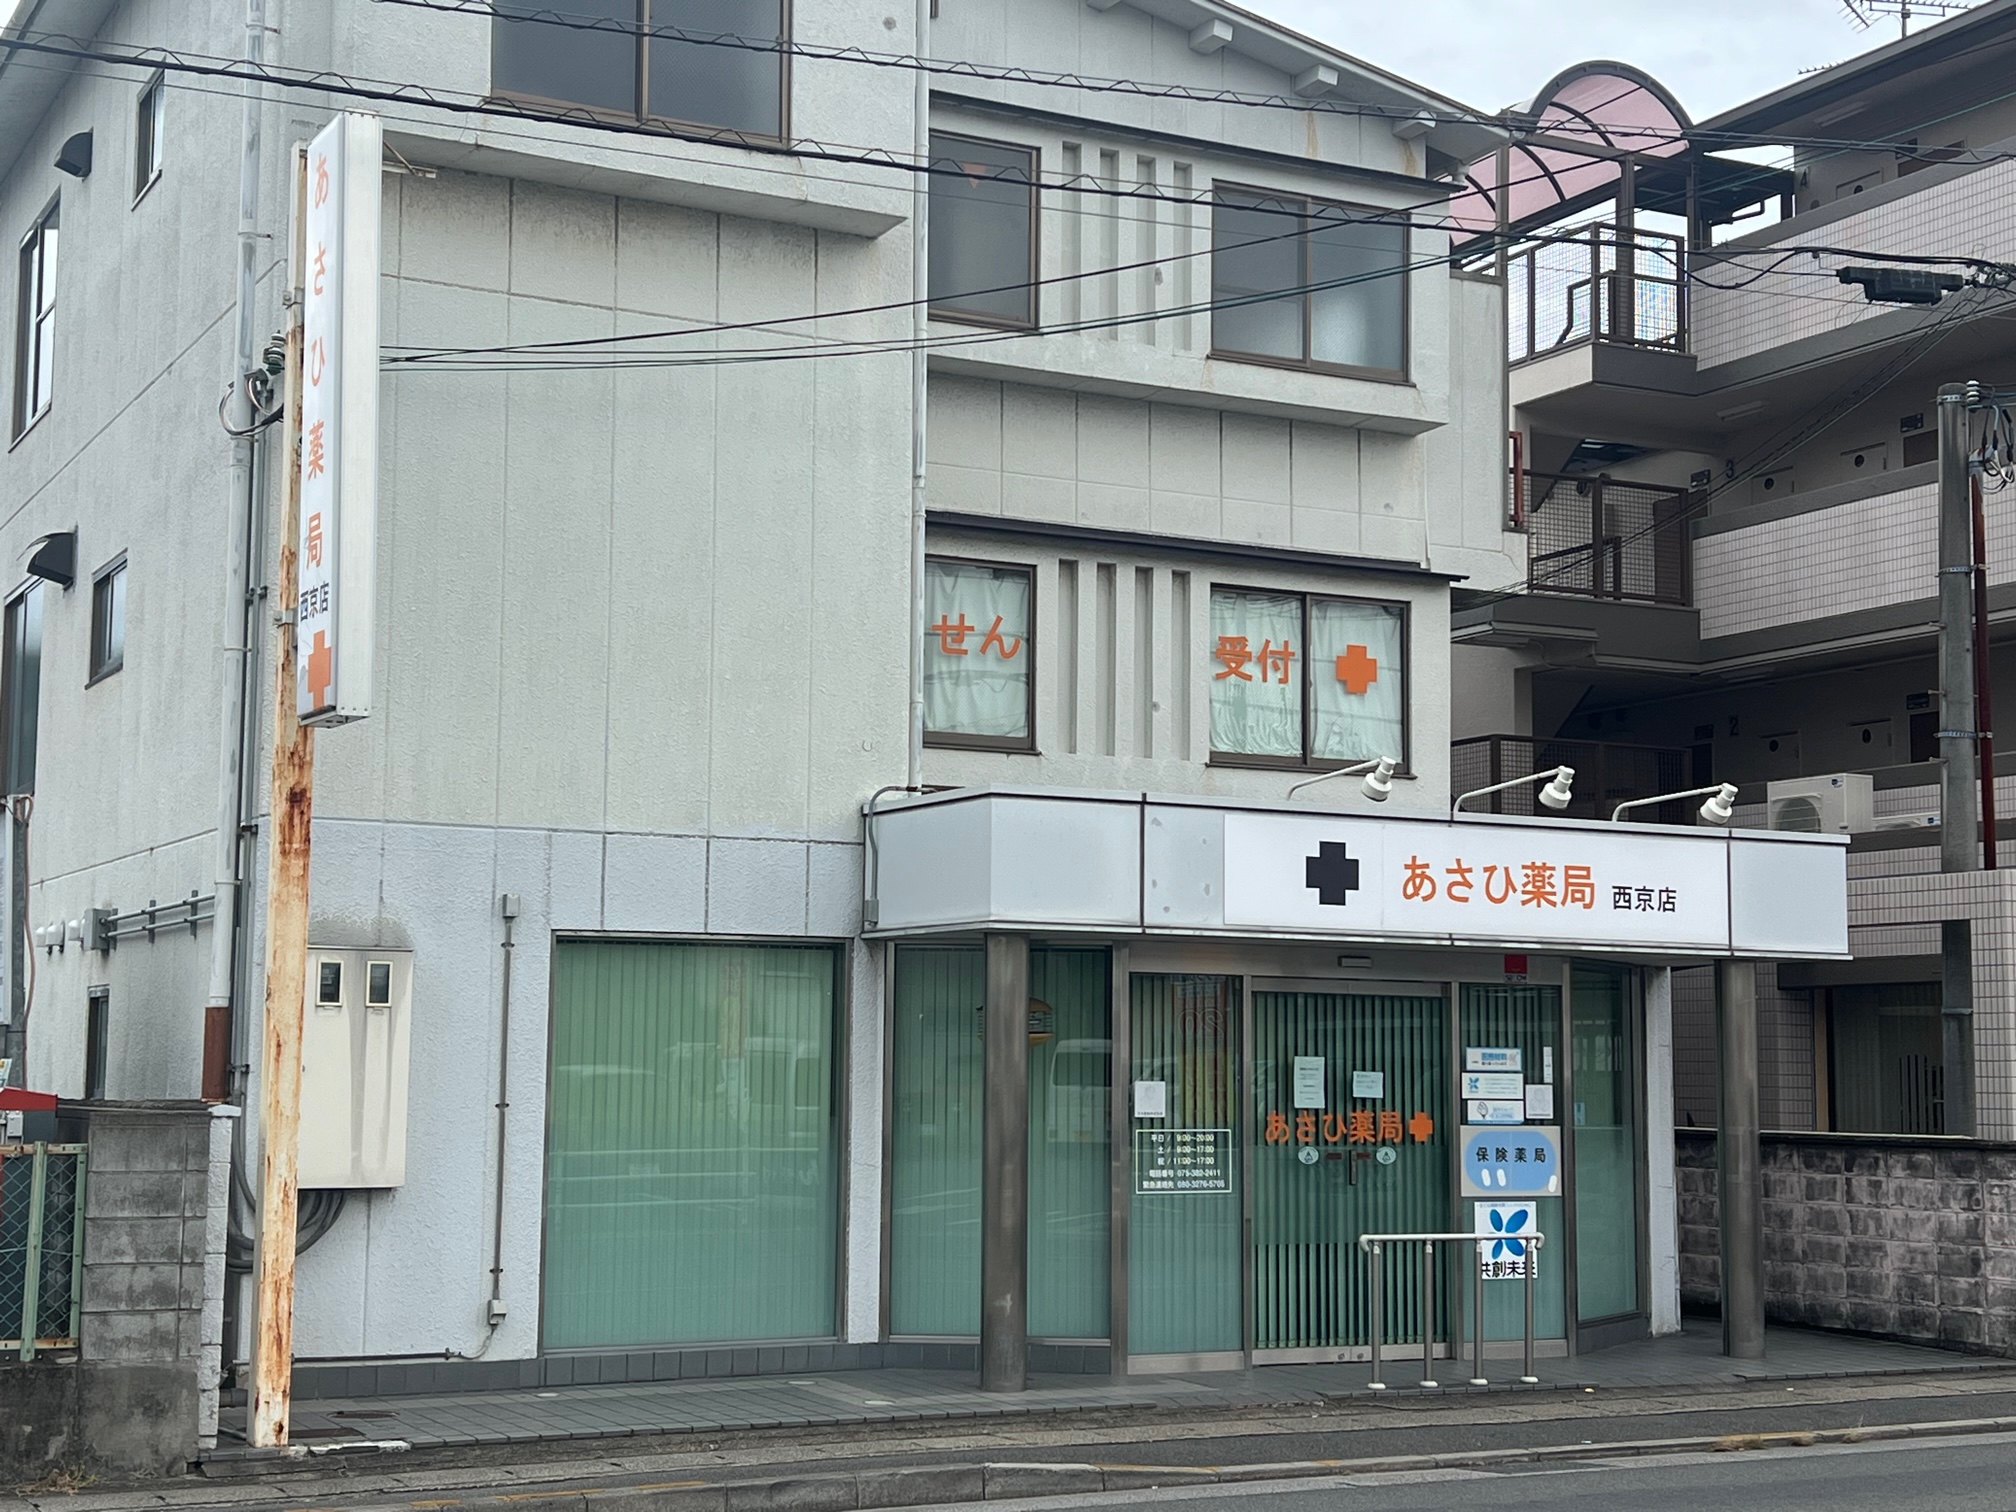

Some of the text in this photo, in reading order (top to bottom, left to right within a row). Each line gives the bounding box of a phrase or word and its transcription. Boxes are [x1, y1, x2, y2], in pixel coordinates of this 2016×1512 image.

[305, 151, 330, 570] あさひ薬局
[1726, 459, 1735, 479] 3
[300, 580, 330, 622] 西京店
[931, 612, 1021, 660] せん
[1214, 635, 1296, 685] 受付
[1729, 715, 1739, 736] 2
[1402, 855, 1596, 910] あさひ薬局
[1612, 886, 1677, 913] 西京店
[1265, 1109, 1403, 1144] あさひ薬局
[1476, 1147, 1546, 1163] 保険薬局
